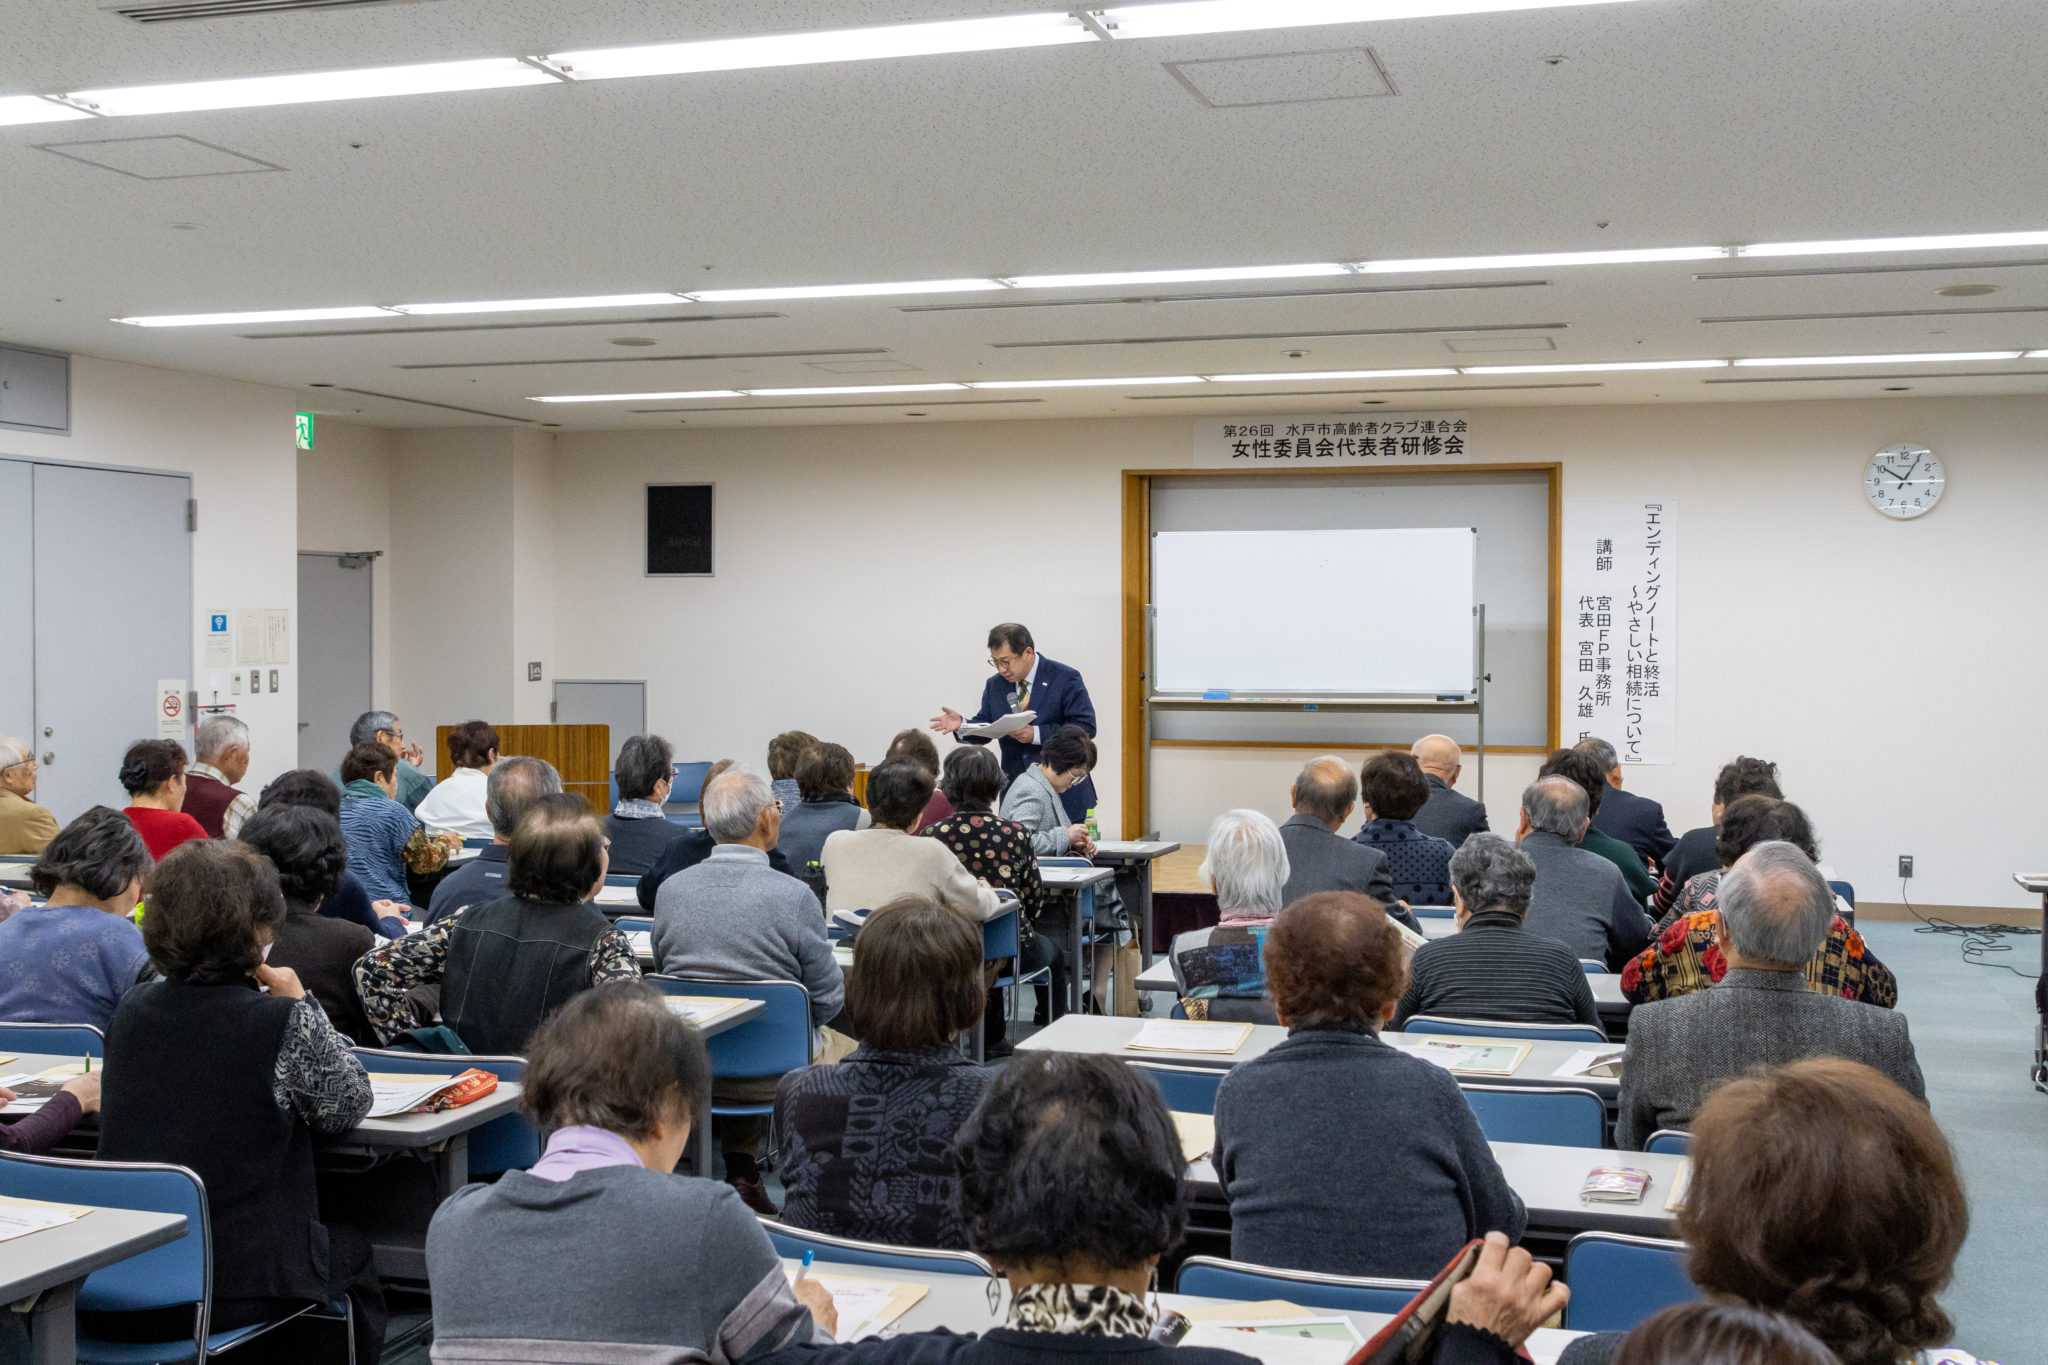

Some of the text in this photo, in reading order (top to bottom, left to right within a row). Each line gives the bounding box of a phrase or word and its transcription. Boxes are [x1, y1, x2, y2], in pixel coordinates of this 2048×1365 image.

[1223, 419, 1468, 437] 第26回 水戸市高齢者クラブ連合会
[1232, 435, 1465, 458] 女性委員会代表者研修会
[1886, 456, 1895, 464] 11
[1900, 452, 1909, 460] 12
[1876, 465, 1885, 474] 10
[1924, 463, 1931, 472] 2
[1873, 478, 1880, 486] 9
[1878, 490, 1885, 498] 8
[1924, 489, 1931, 497] 4
[1888, 498, 1895, 506] 7
[1914, 498, 1921, 506] 5
[1596, 539, 1613, 571] 講師
[1578, 595, 1594, 628] 代表
[1578, 641, 1594, 672] 宮田
[1578, 685, 1594, 718] 久雄
